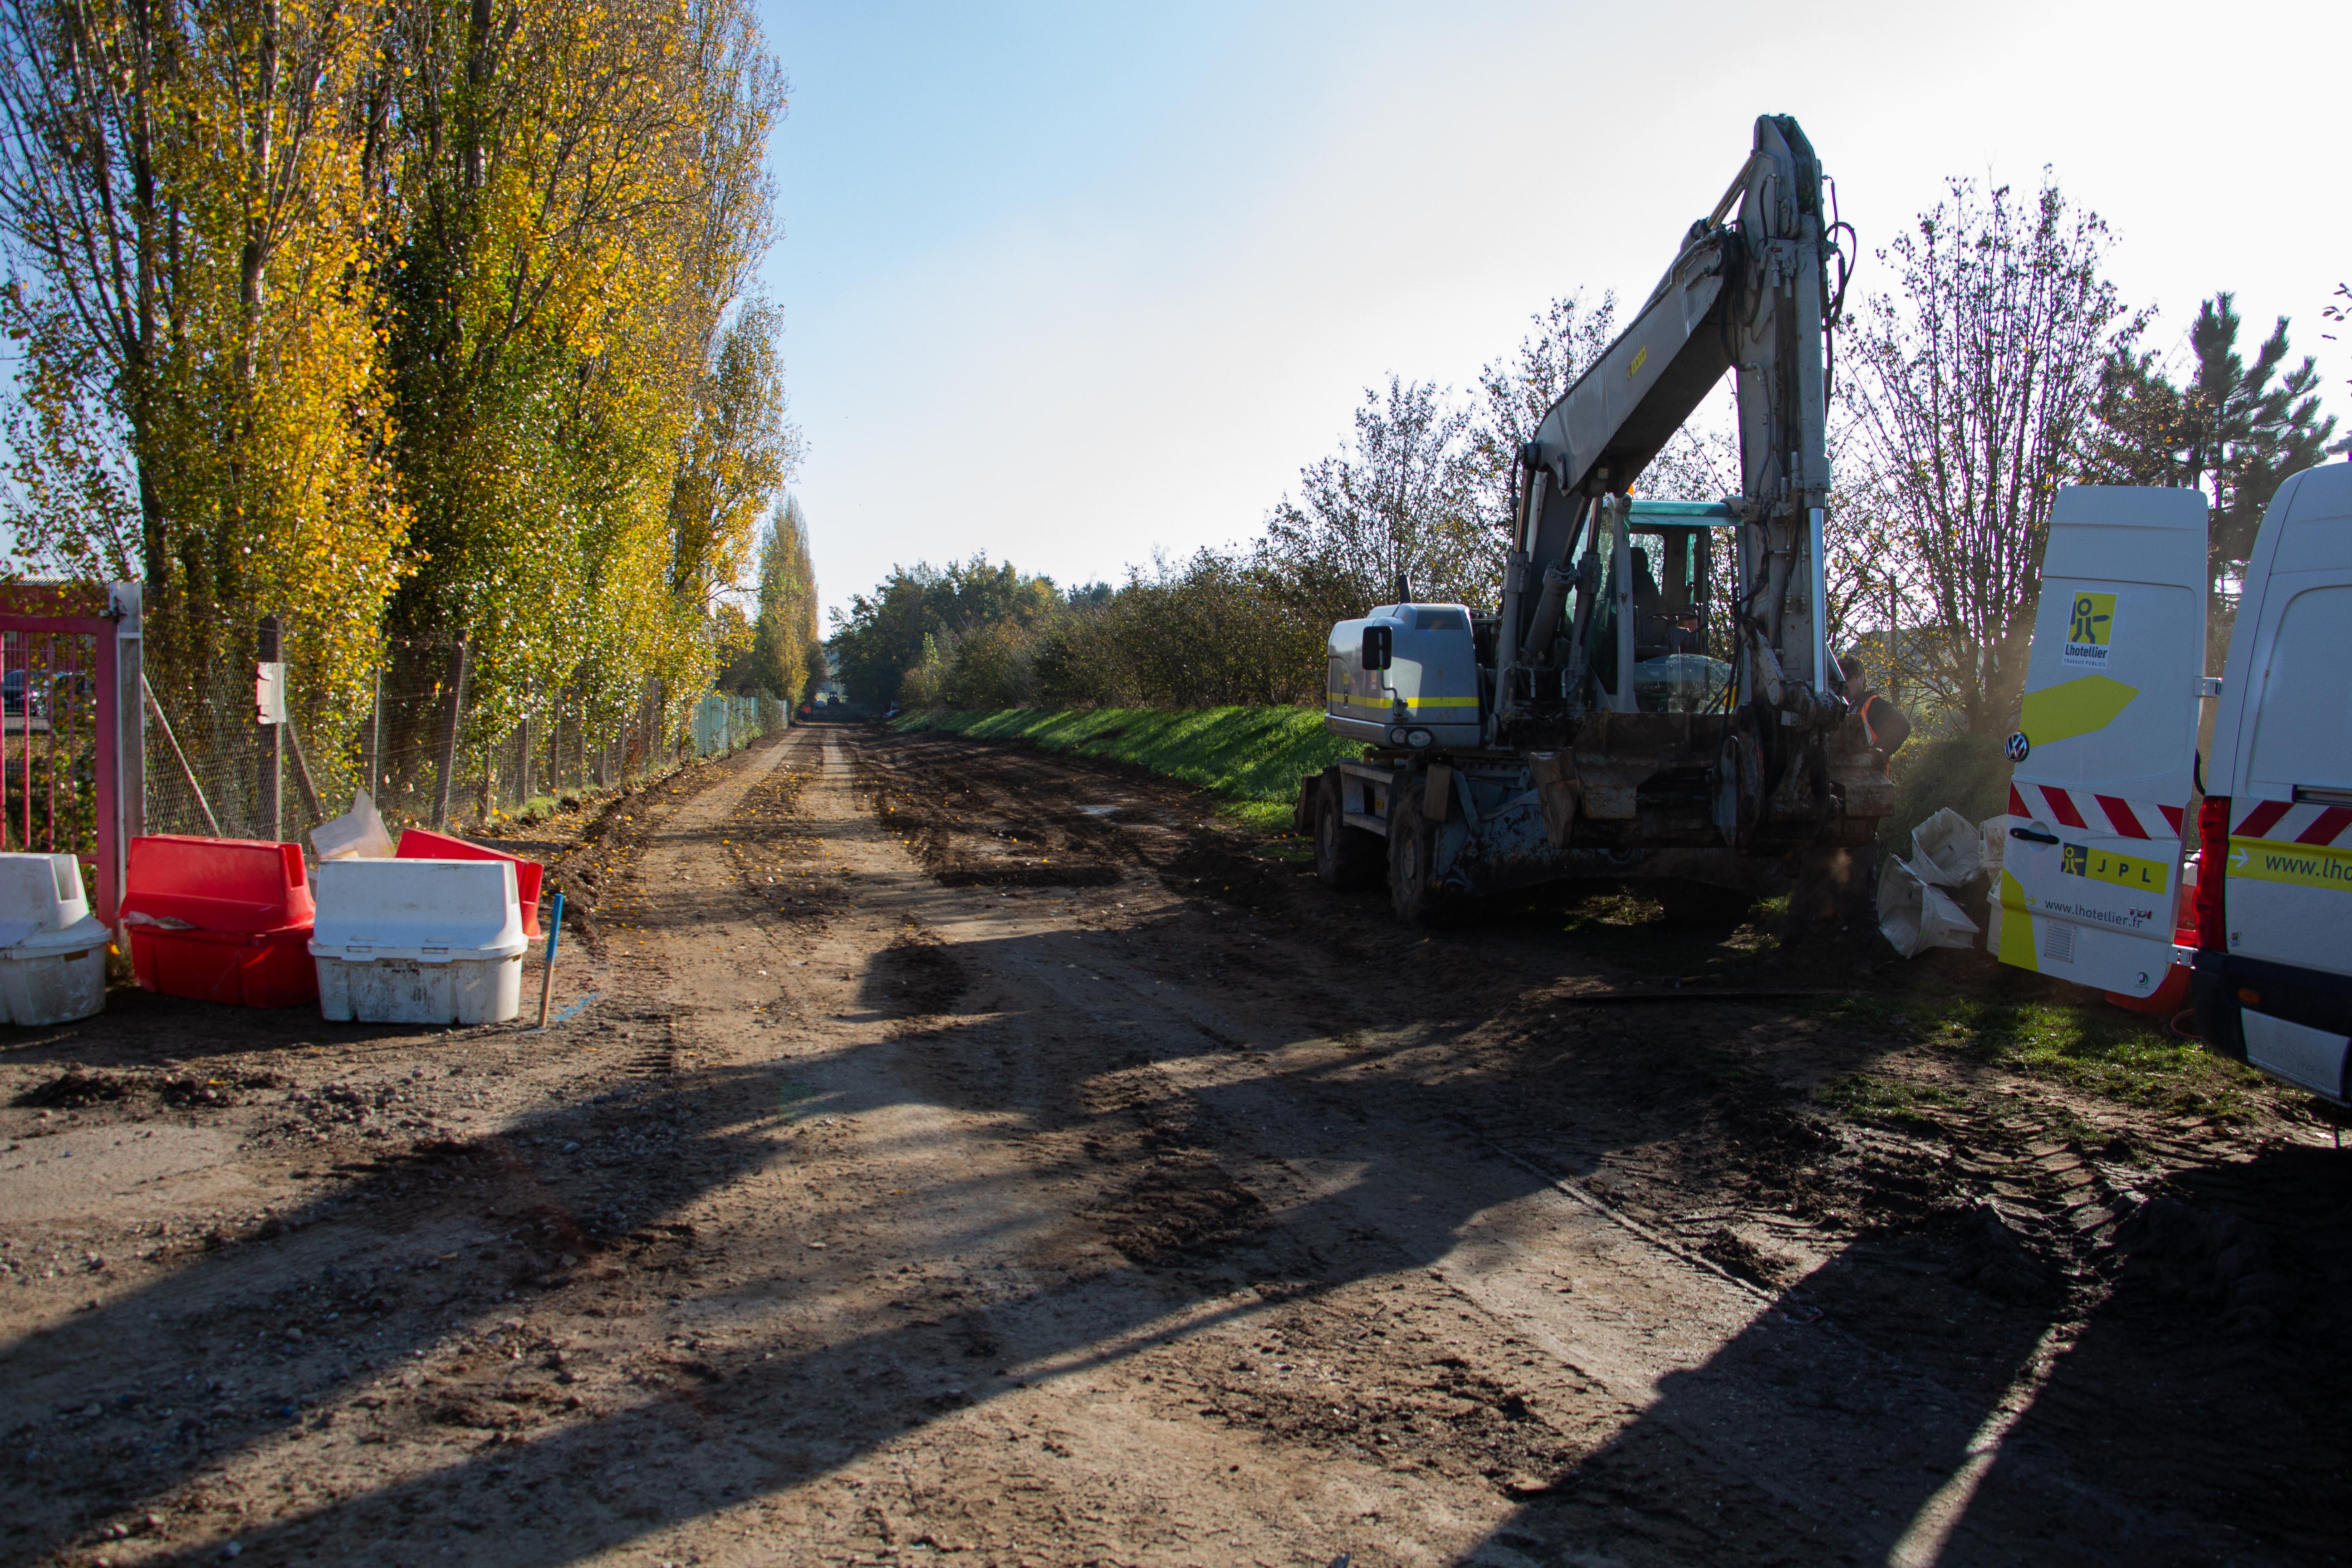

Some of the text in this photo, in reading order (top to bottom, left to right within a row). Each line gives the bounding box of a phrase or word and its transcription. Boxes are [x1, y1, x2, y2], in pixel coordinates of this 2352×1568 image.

[2065, 644, 2107, 659] Lhotellier
[2045, 900, 2142, 928] www.lhotellier.fr
[2128, 906, 2153, 920] TDI
